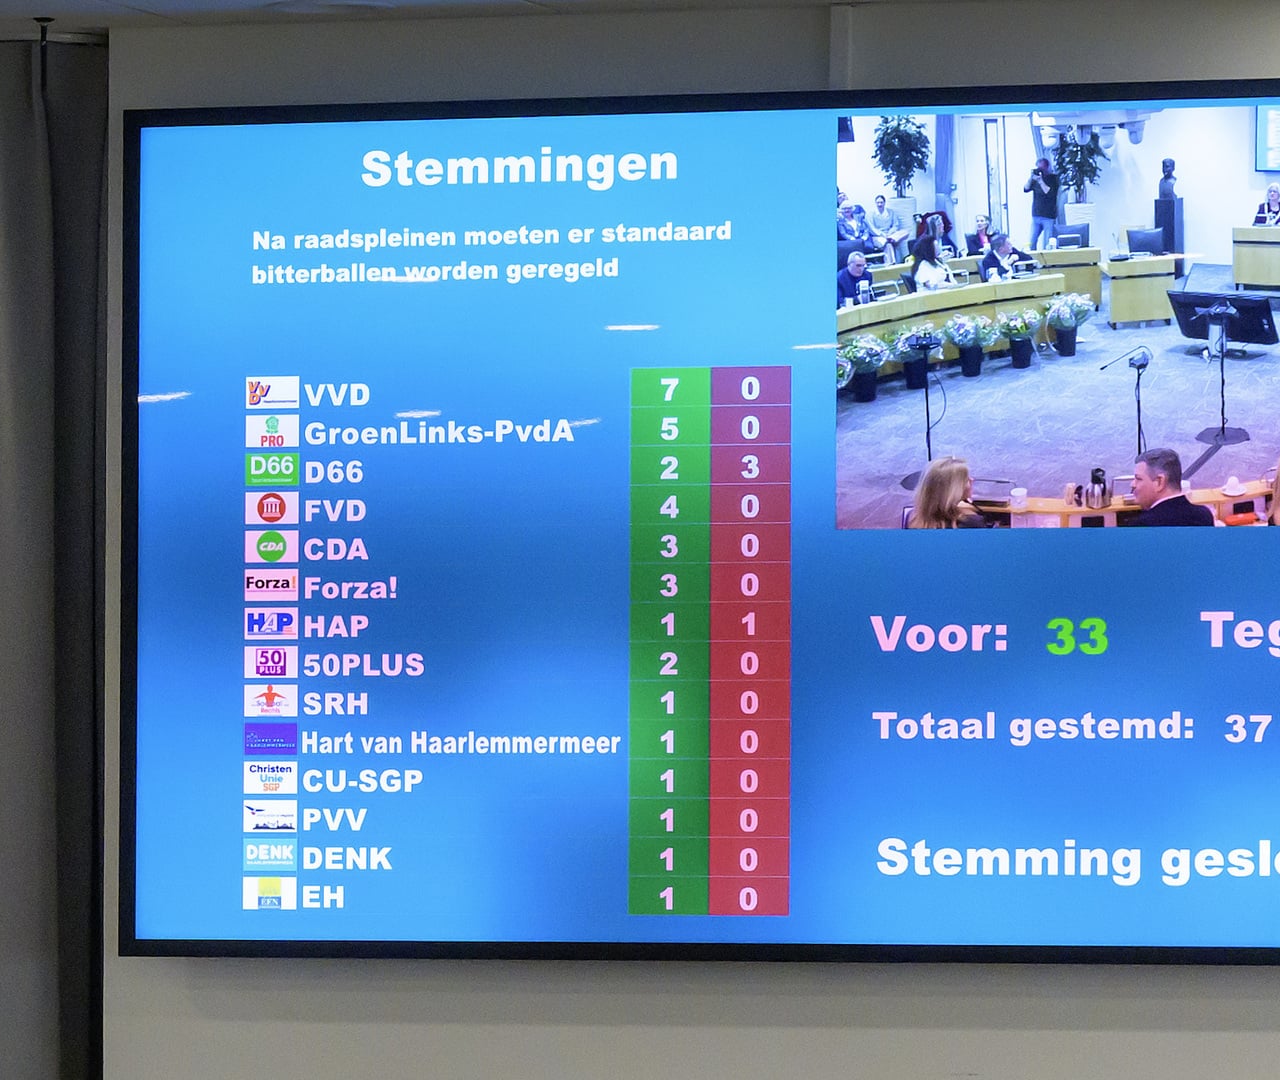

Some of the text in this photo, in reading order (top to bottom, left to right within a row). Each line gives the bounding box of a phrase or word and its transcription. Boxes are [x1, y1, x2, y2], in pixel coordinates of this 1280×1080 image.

[362, 147, 677, 190] Stemmingen
[254, 221, 731, 252] Na raadspleinen moeten er standaard
[253, 258, 618, 284] bitterballen worden geregeld
[304, 384, 369, 406] VVD
[661, 378, 679, 401] 7
[742, 377, 760, 400] 0
[305, 419, 575, 445] GroenLinks-PvdA
[661, 418, 678, 440] 5
[742, 416, 759, 439] 0
[260, 435, 284, 447] PRO
[250, 455, 294, 475] D66
[306, 461, 363, 483] D66
[661, 456, 678, 479] 2
[741, 455, 759, 478] 3
[306, 500, 366, 521] FVD
[660, 496, 679, 518] 4
[741, 495, 759, 517] 0
[259, 542, 283, 551] CDA
[304, 538, 368, 560] CDA
[661, 535, 678, 557] 3
[741, 534, 759, 557] 0
[246, 576, 296, 589] Forza!
[305, 577, 396, 599] Forza!
[660, 574, 678, 597] 3
[741, 573, 758, 596] 0
[247, 612, 293, 632] HAP
[305, 616, 368, 637] HAP
[661, 613, 674, 636] 1
[742, 612, 755, 635] 1
[870, 616, 1108, 655] Voor: 33
[260, 650, 282, 665] 50
[304, 653, 424, 676] 50PLUS
[660, 652, 678, 675] 2
[741, 652, 758, 674] 0
[260, 666, 282, 674] PLUS
[304, 693, 367, 715] SRH
[661, 691, 674, 714] 1
[741, 691, 758, 714] 0
[872, 711, 1272, 746] Totaal gestemd: 37
[302, 731, 620, 753] Hart van Haarlemmermeer
[661, 730, 673, 753] 1
[741, 730, 758, 753] 0
[249, 765, 292, 773] Christen
[260, 774, 283, 782] Unie
[263, 783, 280, 791] SGP
[303, 770, 422, 792] CU-SGP
[661, 769, 673, 792] 1
[740, 770, 758, 792] 0
[304, 809, 367, 830] PVV
[660, 809, 673, 831] 1
[740, 809, 758, 832] 0
[246, 844, 293, 860] DENK
[304, 847, 392, 869] DENK
[660, 848, 673, 871] 1
[740, 848, 757, 871] 0
[877, 838, 1140, 886] Stemming
[303, 886, 343, 908] EH
[660, 887, 673, 910] 1
[740, 888, 757, 910] 0
